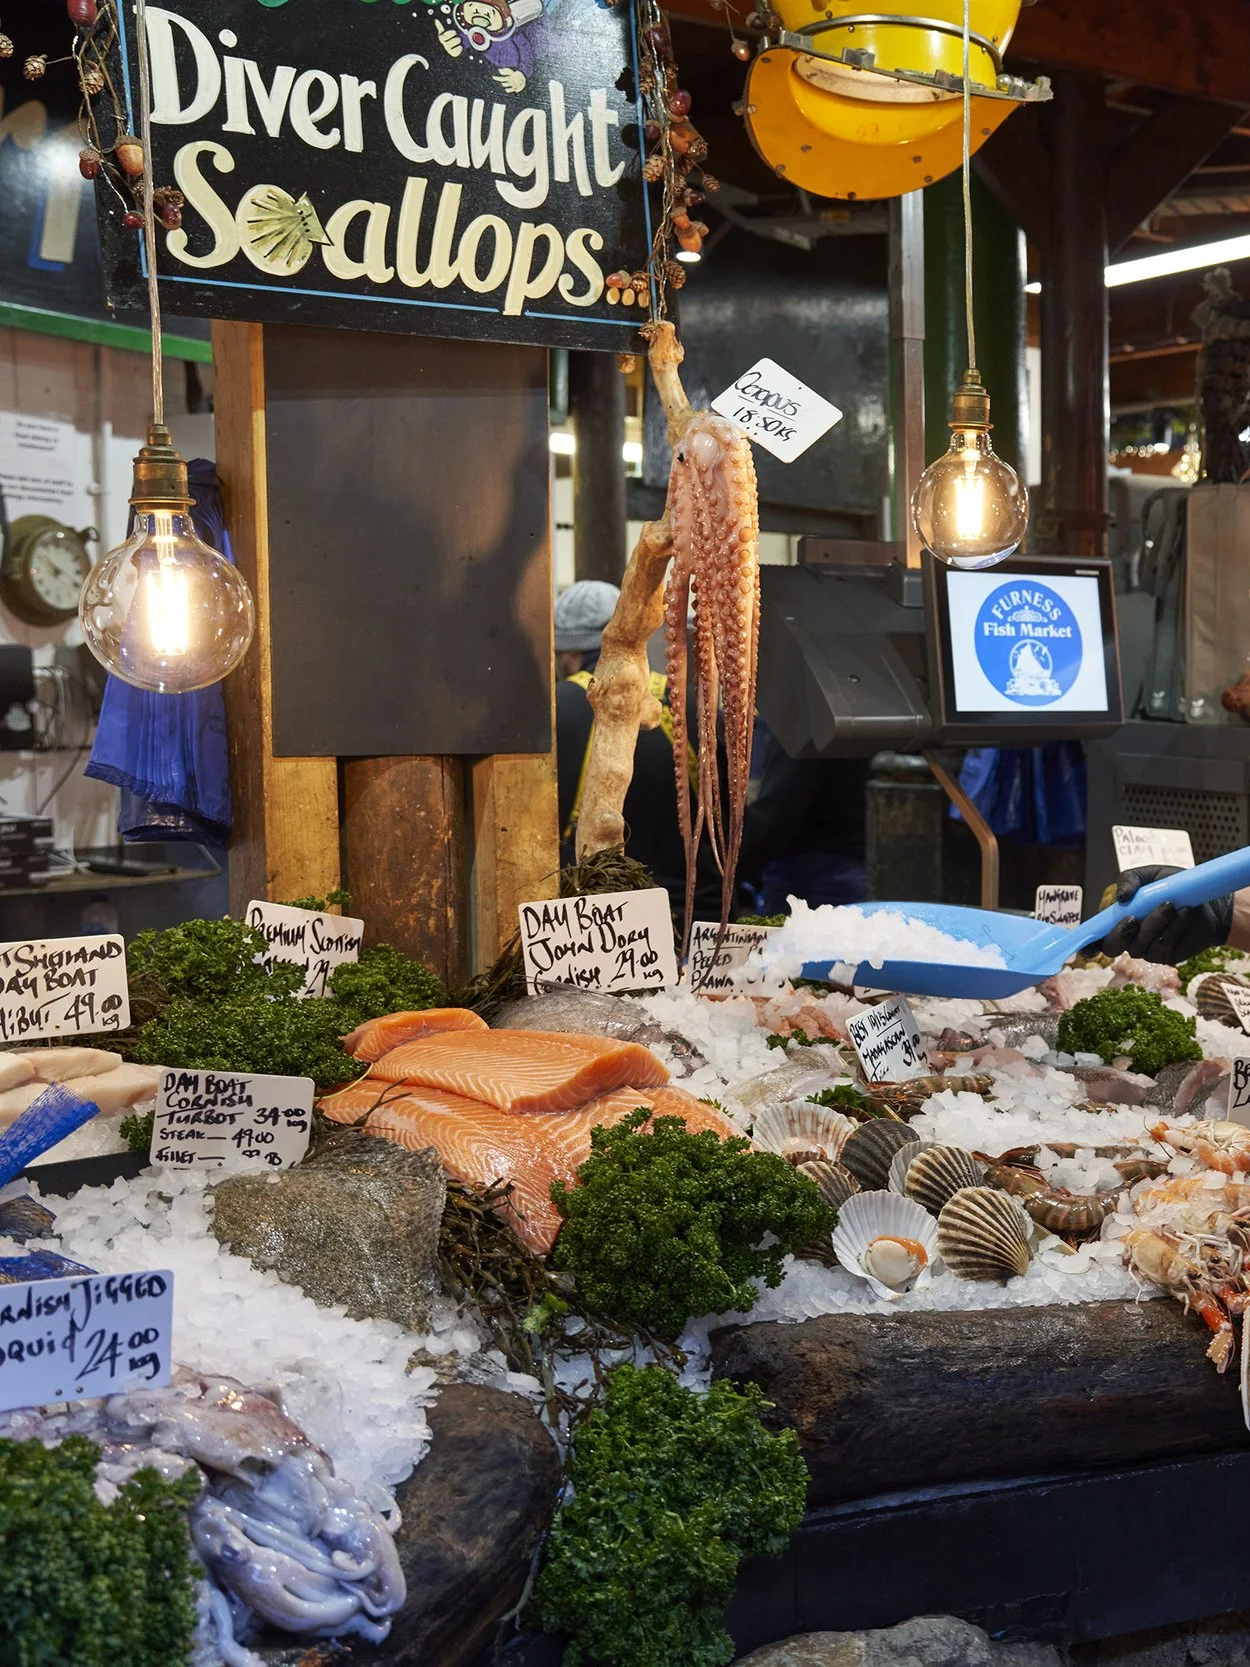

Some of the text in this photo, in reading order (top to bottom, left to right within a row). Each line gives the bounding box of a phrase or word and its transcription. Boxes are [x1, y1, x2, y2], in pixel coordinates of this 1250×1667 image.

[134, 4, 625, 209] Diver Caught
[165, 139, 604, 316] Scallops
[990, 589, 1062, 621] FURNESS
[983, 621, 1073, 639] Fish Market
[250, 906, 307, 954] PREMIUM
[522, 896, 630, 940] DAY BOAT
[527, 920, 652, 972] JOHN DORY
[693, 925, 768, 950] ARGNTINIAN
[692, 950, 733, 971] PEEED
[43, 967, 99, 992] BOAT
[102, 1013, 120, 1031] kg
[163, 1072, 253, 1095] DAY BOAT
[157, 1108, 244, 1125] TURBOT
[159, 1128, 206, 1141] STEAK
